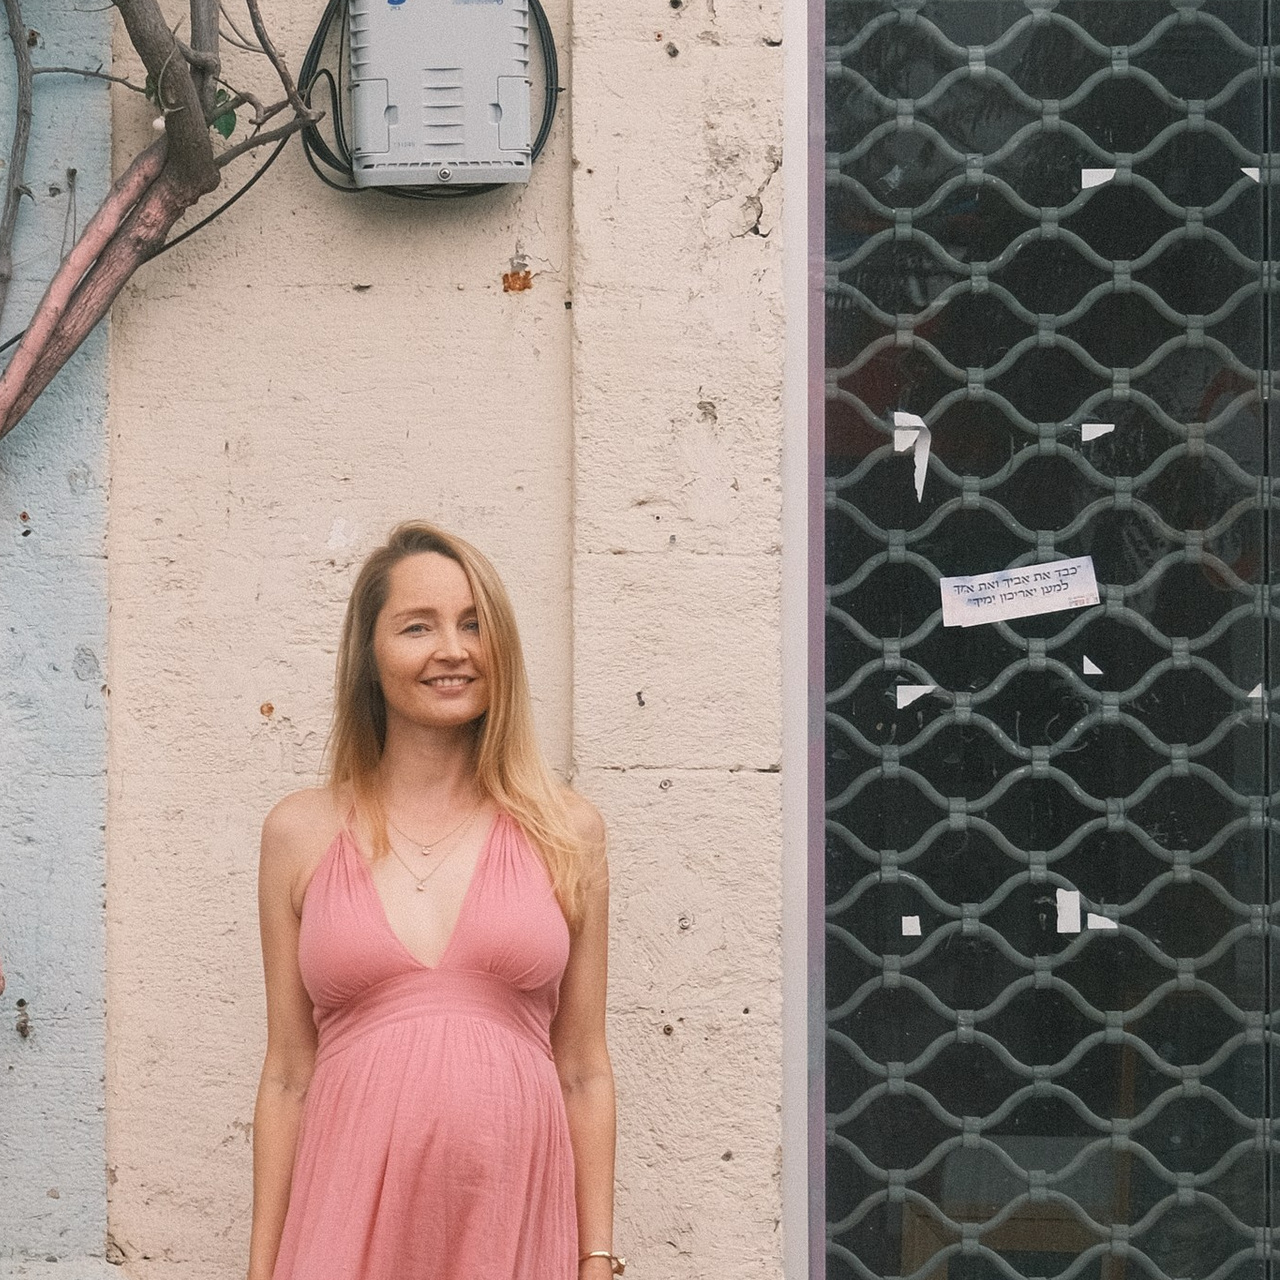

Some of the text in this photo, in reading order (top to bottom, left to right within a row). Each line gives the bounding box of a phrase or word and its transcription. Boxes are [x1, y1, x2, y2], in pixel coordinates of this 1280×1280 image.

[1002, 575, 1030, 588] אביך
[1033, 571, 1051, 582] את
[978, 580, 1000, 592] ואת
[1040, 580, 1069, 596] למען
[999, 589, 1037, 604] יאריכון
